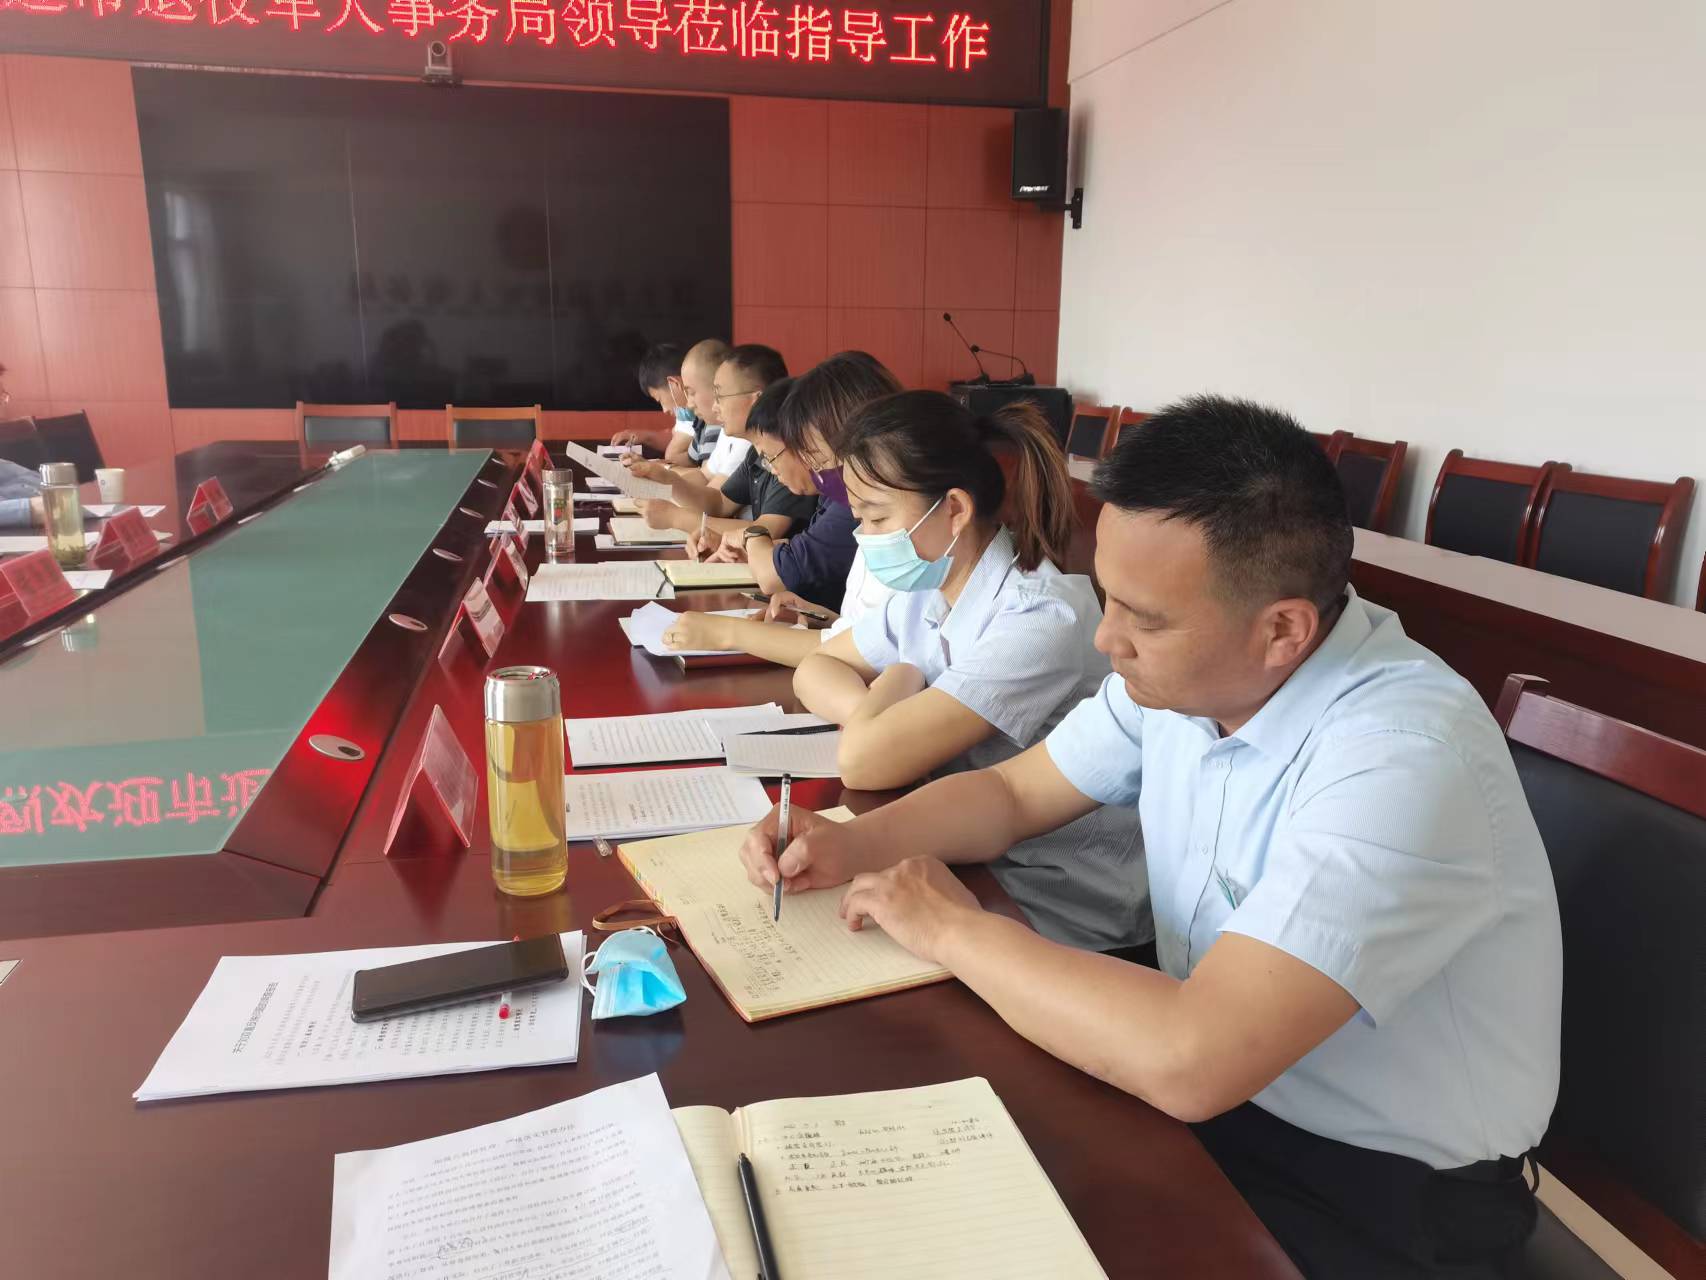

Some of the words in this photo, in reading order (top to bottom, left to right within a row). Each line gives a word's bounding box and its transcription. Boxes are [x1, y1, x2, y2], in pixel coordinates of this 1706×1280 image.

[3, 0, 989, 69] 军人事务局领导莅临指导工作
